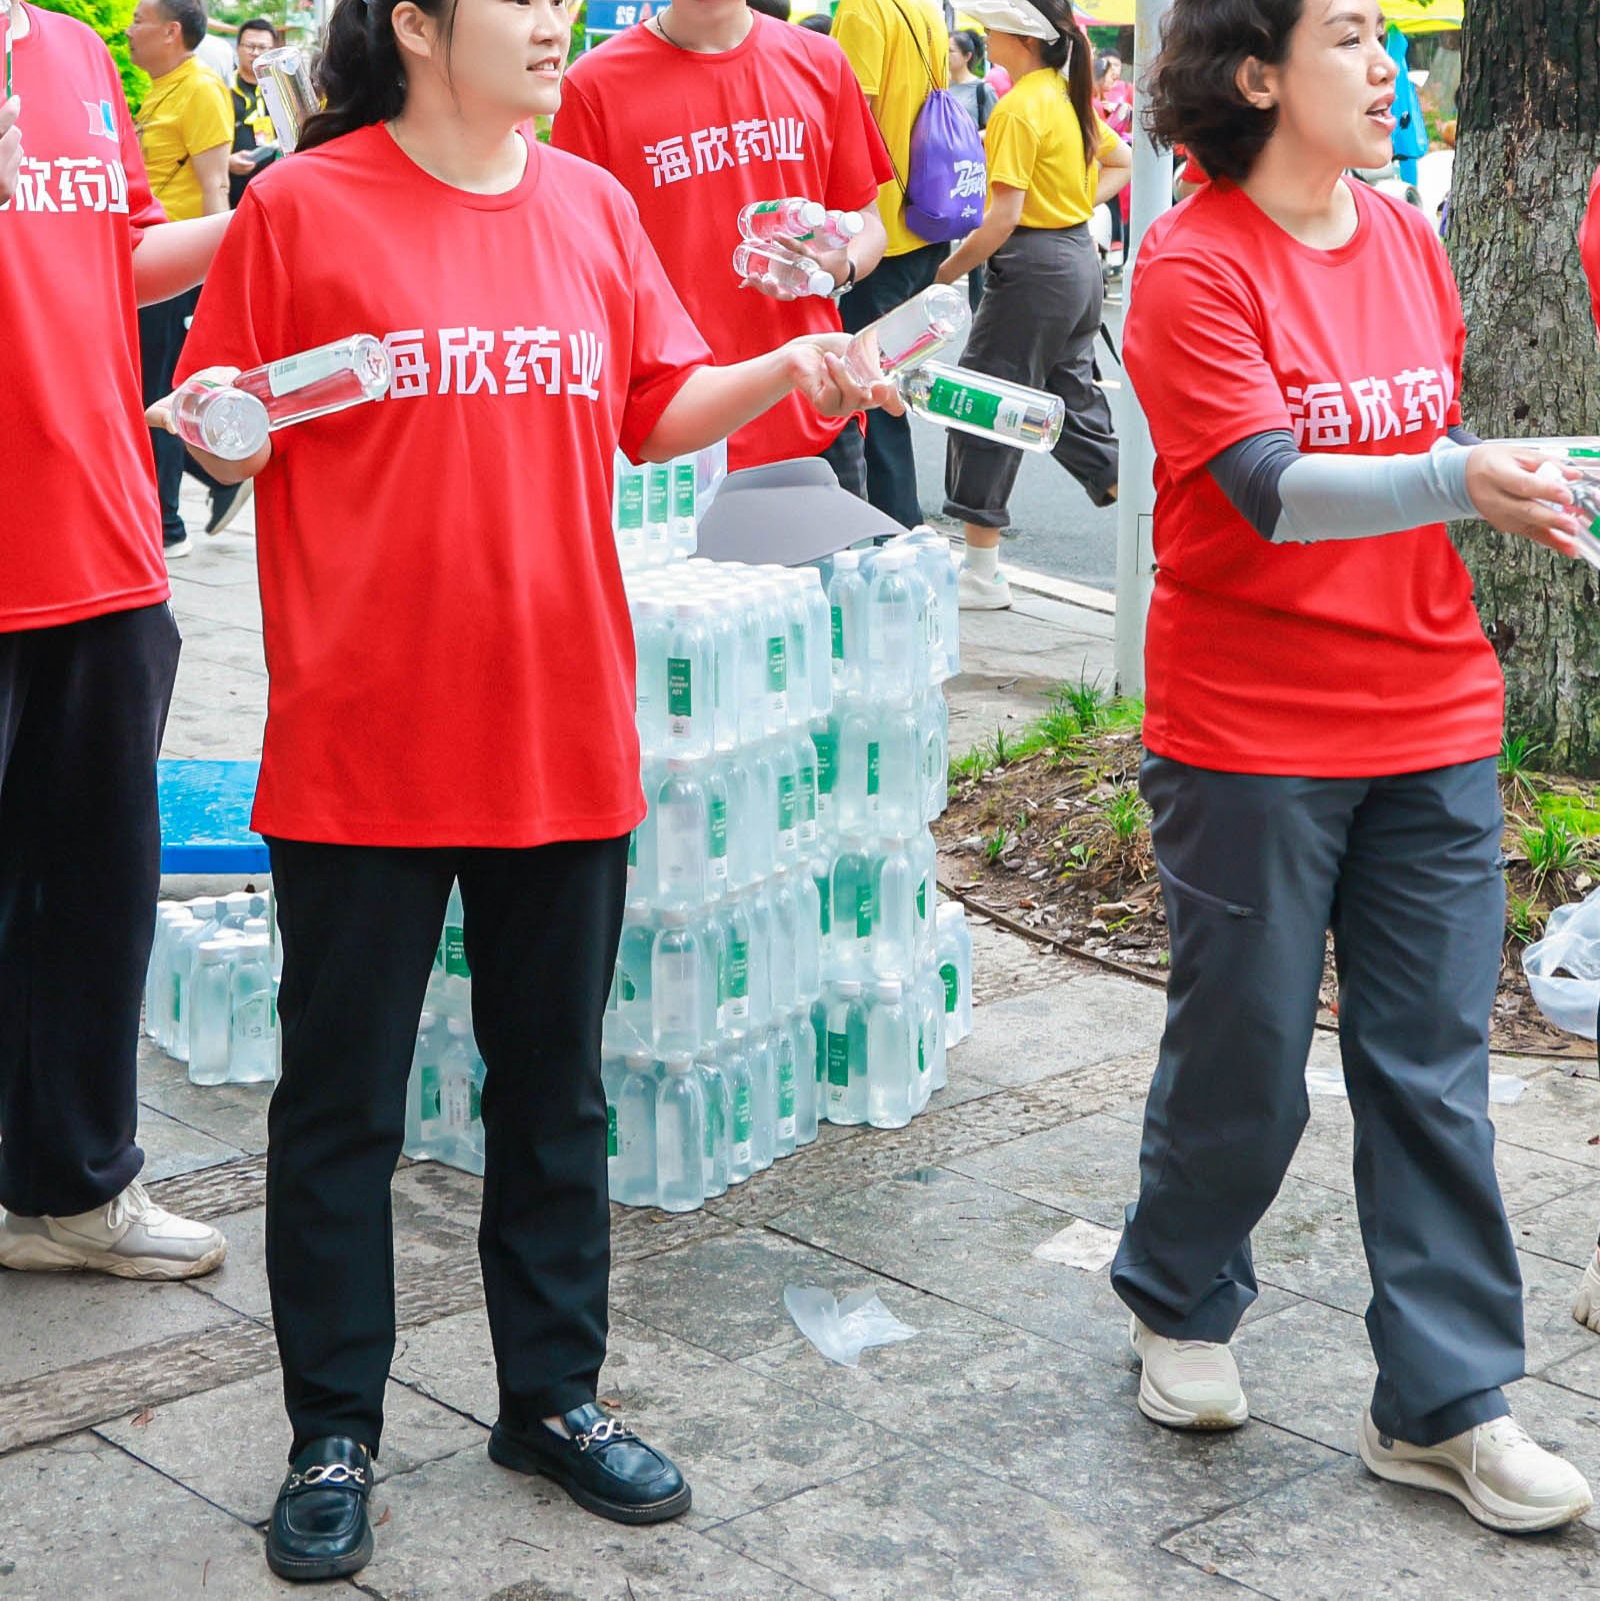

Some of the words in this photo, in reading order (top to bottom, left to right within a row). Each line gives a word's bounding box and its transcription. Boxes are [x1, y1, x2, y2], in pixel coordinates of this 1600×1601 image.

[643, 116, 805, 188] 海欣药业
[376, 326, 604, 402] 海欣药业
[1286, 367, 1456, 448] 海欣药
